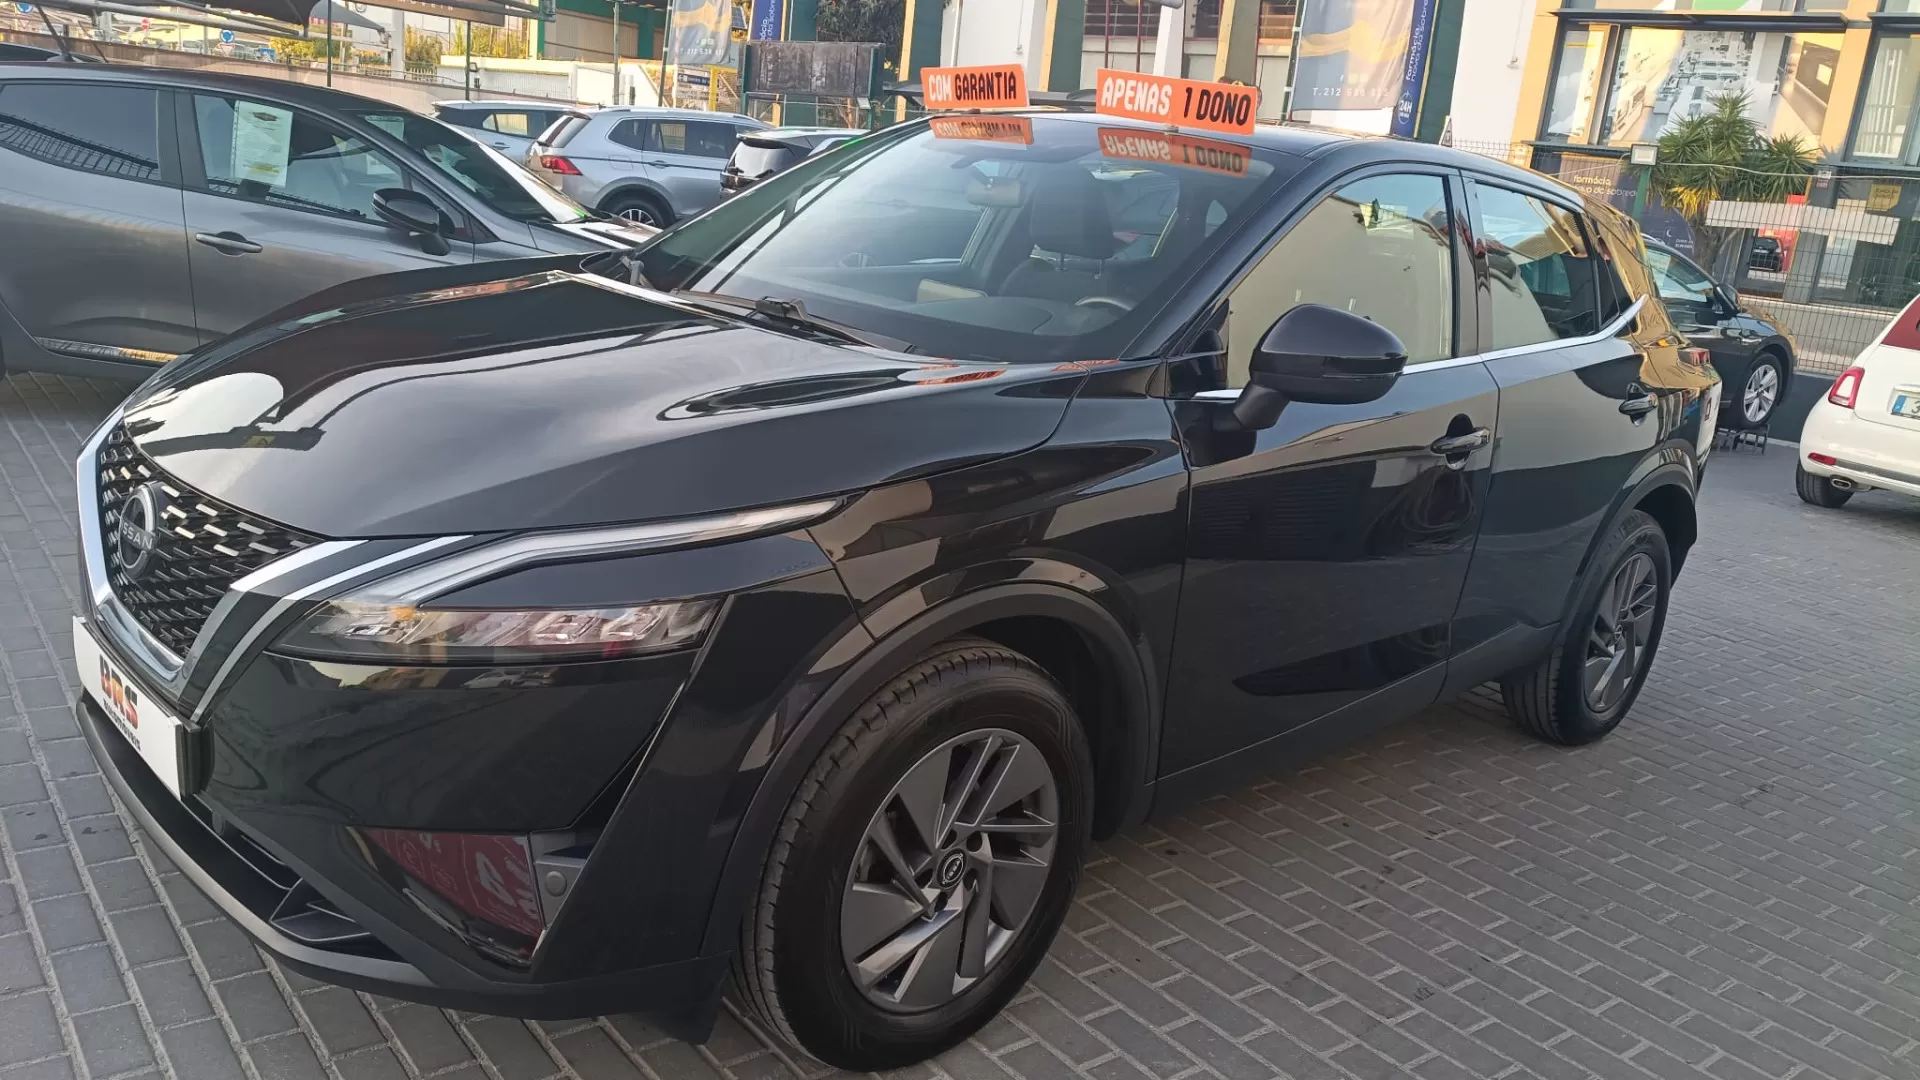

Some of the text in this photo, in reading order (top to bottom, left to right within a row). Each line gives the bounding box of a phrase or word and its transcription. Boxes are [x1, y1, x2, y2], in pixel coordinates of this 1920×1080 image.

[928, 71, 1017, 101] COM GARANTIA
[1101, 76, 1251, 126] APENAS 1 DONO
[99, 654, 138, 730] BRS
